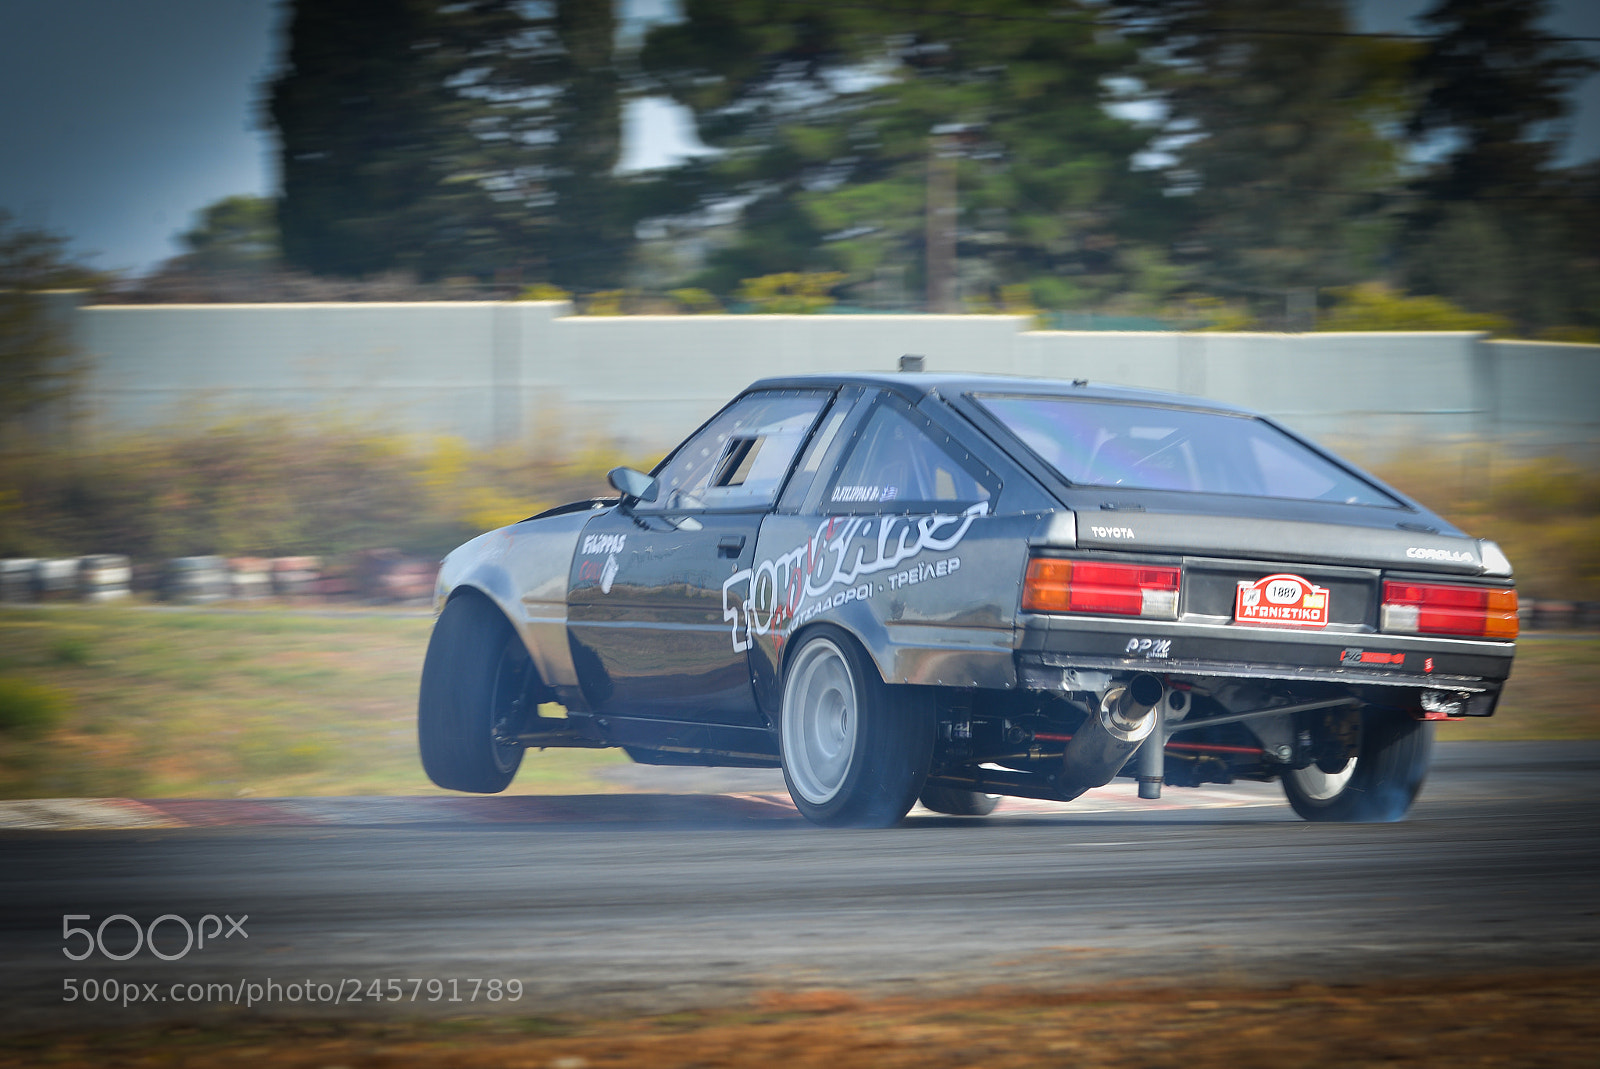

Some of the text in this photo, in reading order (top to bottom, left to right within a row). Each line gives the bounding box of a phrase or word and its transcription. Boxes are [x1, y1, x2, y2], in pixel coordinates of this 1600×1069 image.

[1091, 526, 1135, 539] TOYOTA
[1406, 547, 1473, 562] COROLLA
[1272, 586, 1297, 598] 1889
[1244, 605, 1321, 620] ΑΓΩΝΙΣΤΙΚΟ
